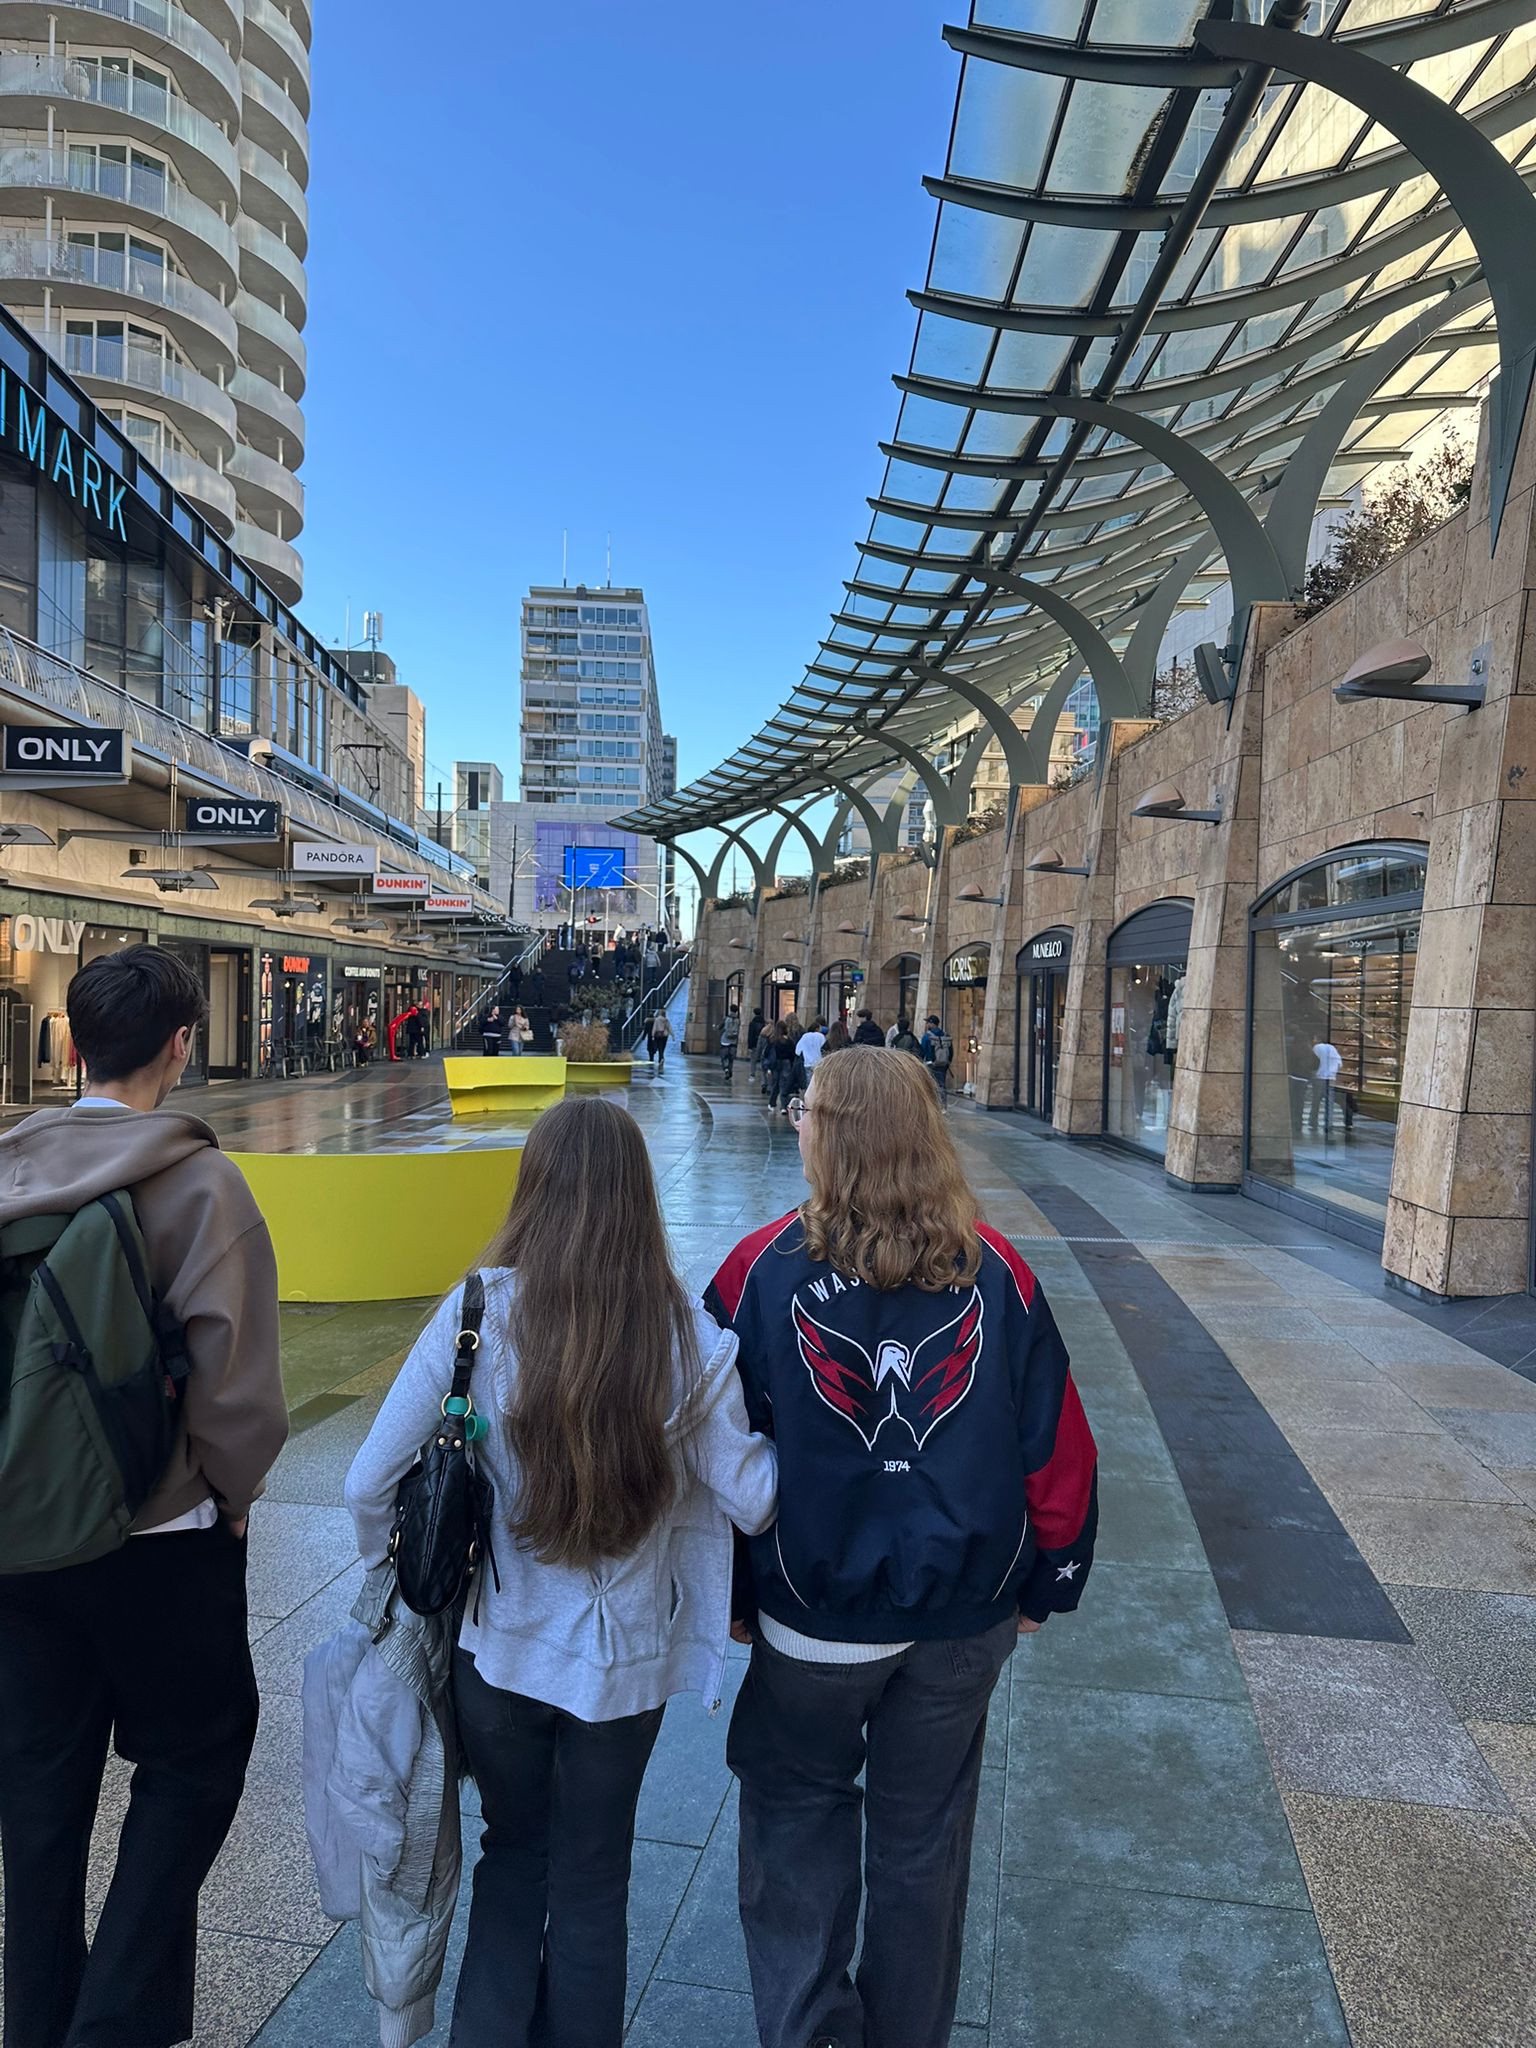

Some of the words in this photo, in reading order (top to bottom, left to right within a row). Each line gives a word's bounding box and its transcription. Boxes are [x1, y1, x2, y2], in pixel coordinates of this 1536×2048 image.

[18, 737, 111, 762] ONLY
[196, 806, 267, 825] ONLY
[306, 852, 364, 864] PANDORA
[376, 878, 426, 889] DUNKIN'
[427, 898, 470, 908] DUNKIN'
[12, 913, 87, 955] ONLY
[949, 956, 973, 982] LORIS
[883, 1460, 911, 1472] 1974
